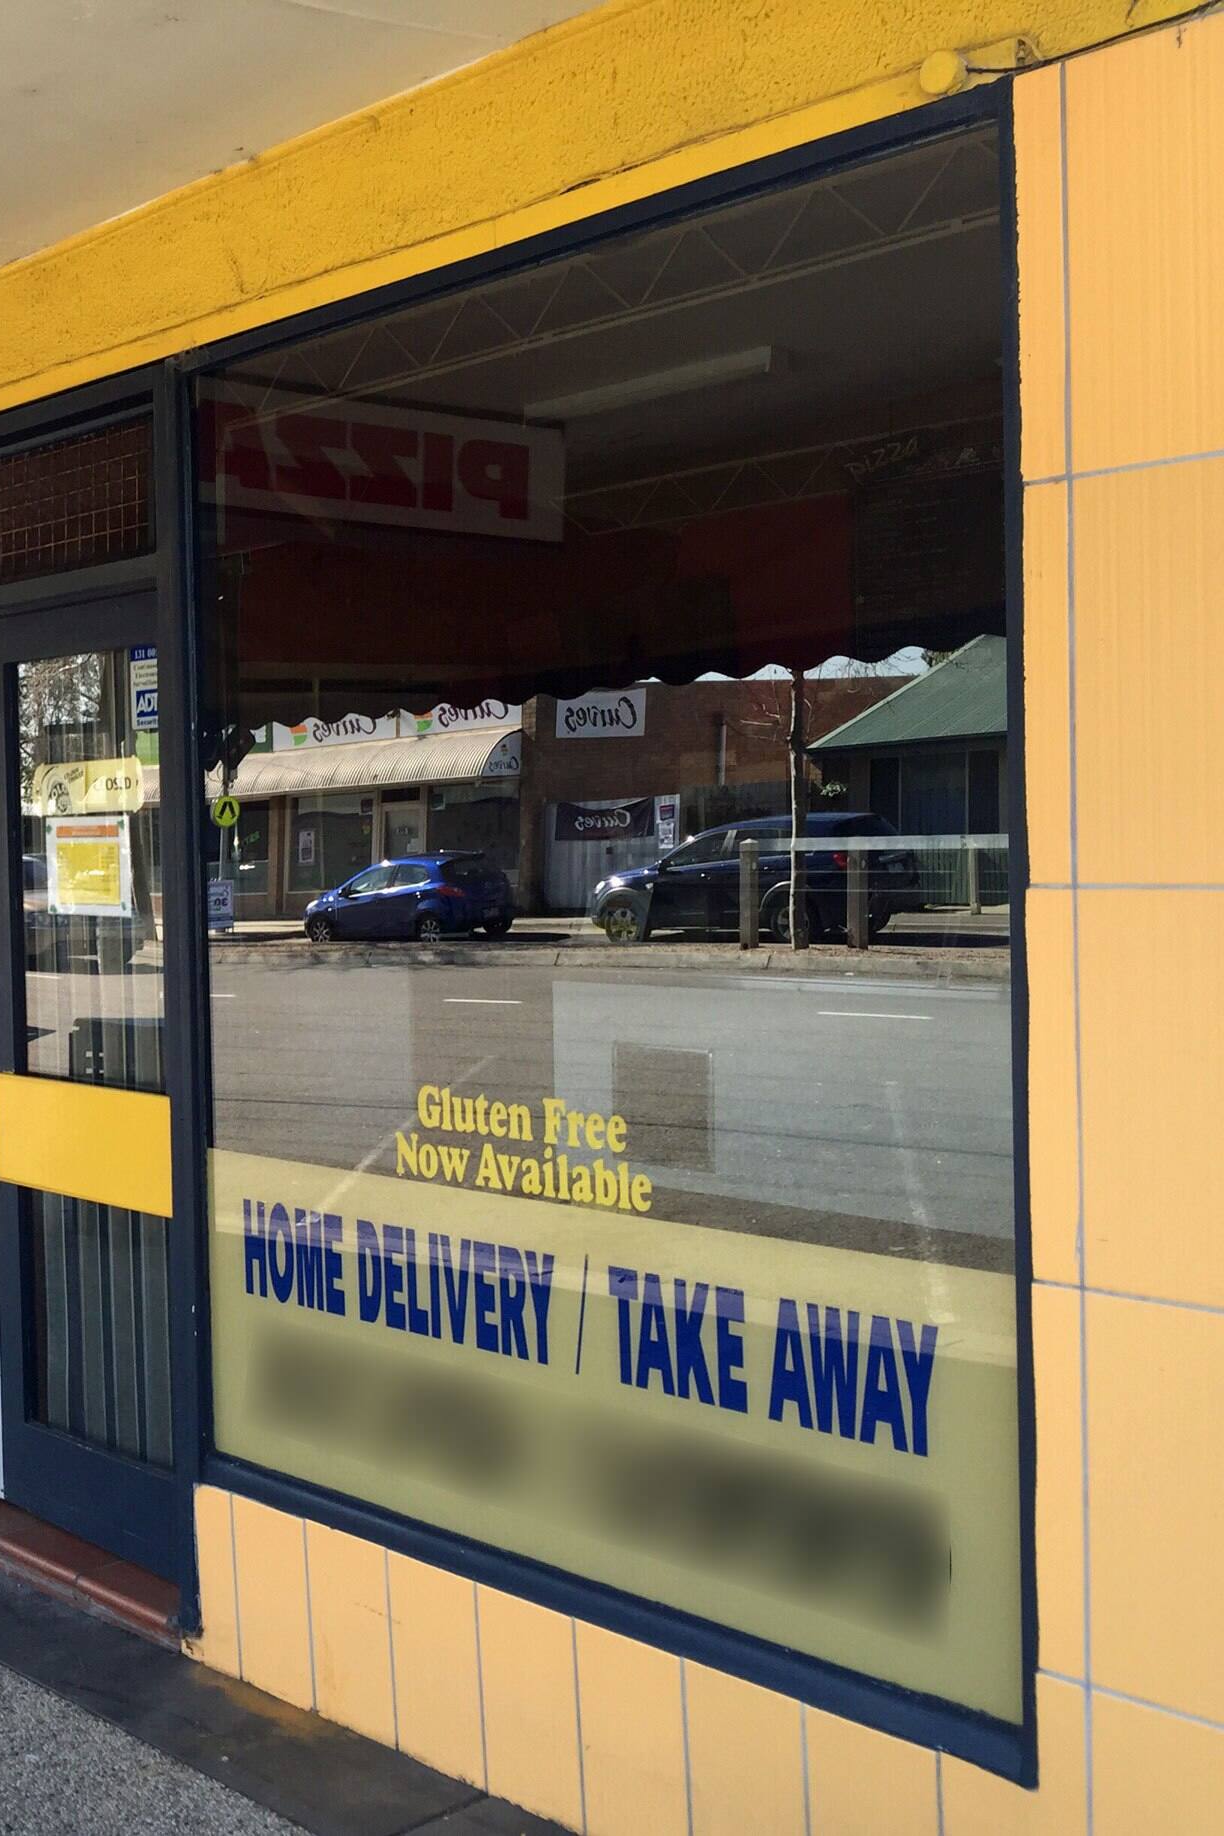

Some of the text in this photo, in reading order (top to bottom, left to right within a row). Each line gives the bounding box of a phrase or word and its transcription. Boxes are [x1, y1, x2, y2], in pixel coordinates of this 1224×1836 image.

[417, 1084, 628, 1153] Gluten Free
[396, 1132, 652, 1213] Now Available
[243, 1198, 346, 1317] HOME
[357, 1219, 555, 1366] DELIVERY
[575, 1253, 590, 1376] /
[608, 1265, 749, 1414] TAKE
[768, 1297, 939, 1459] AWAY
